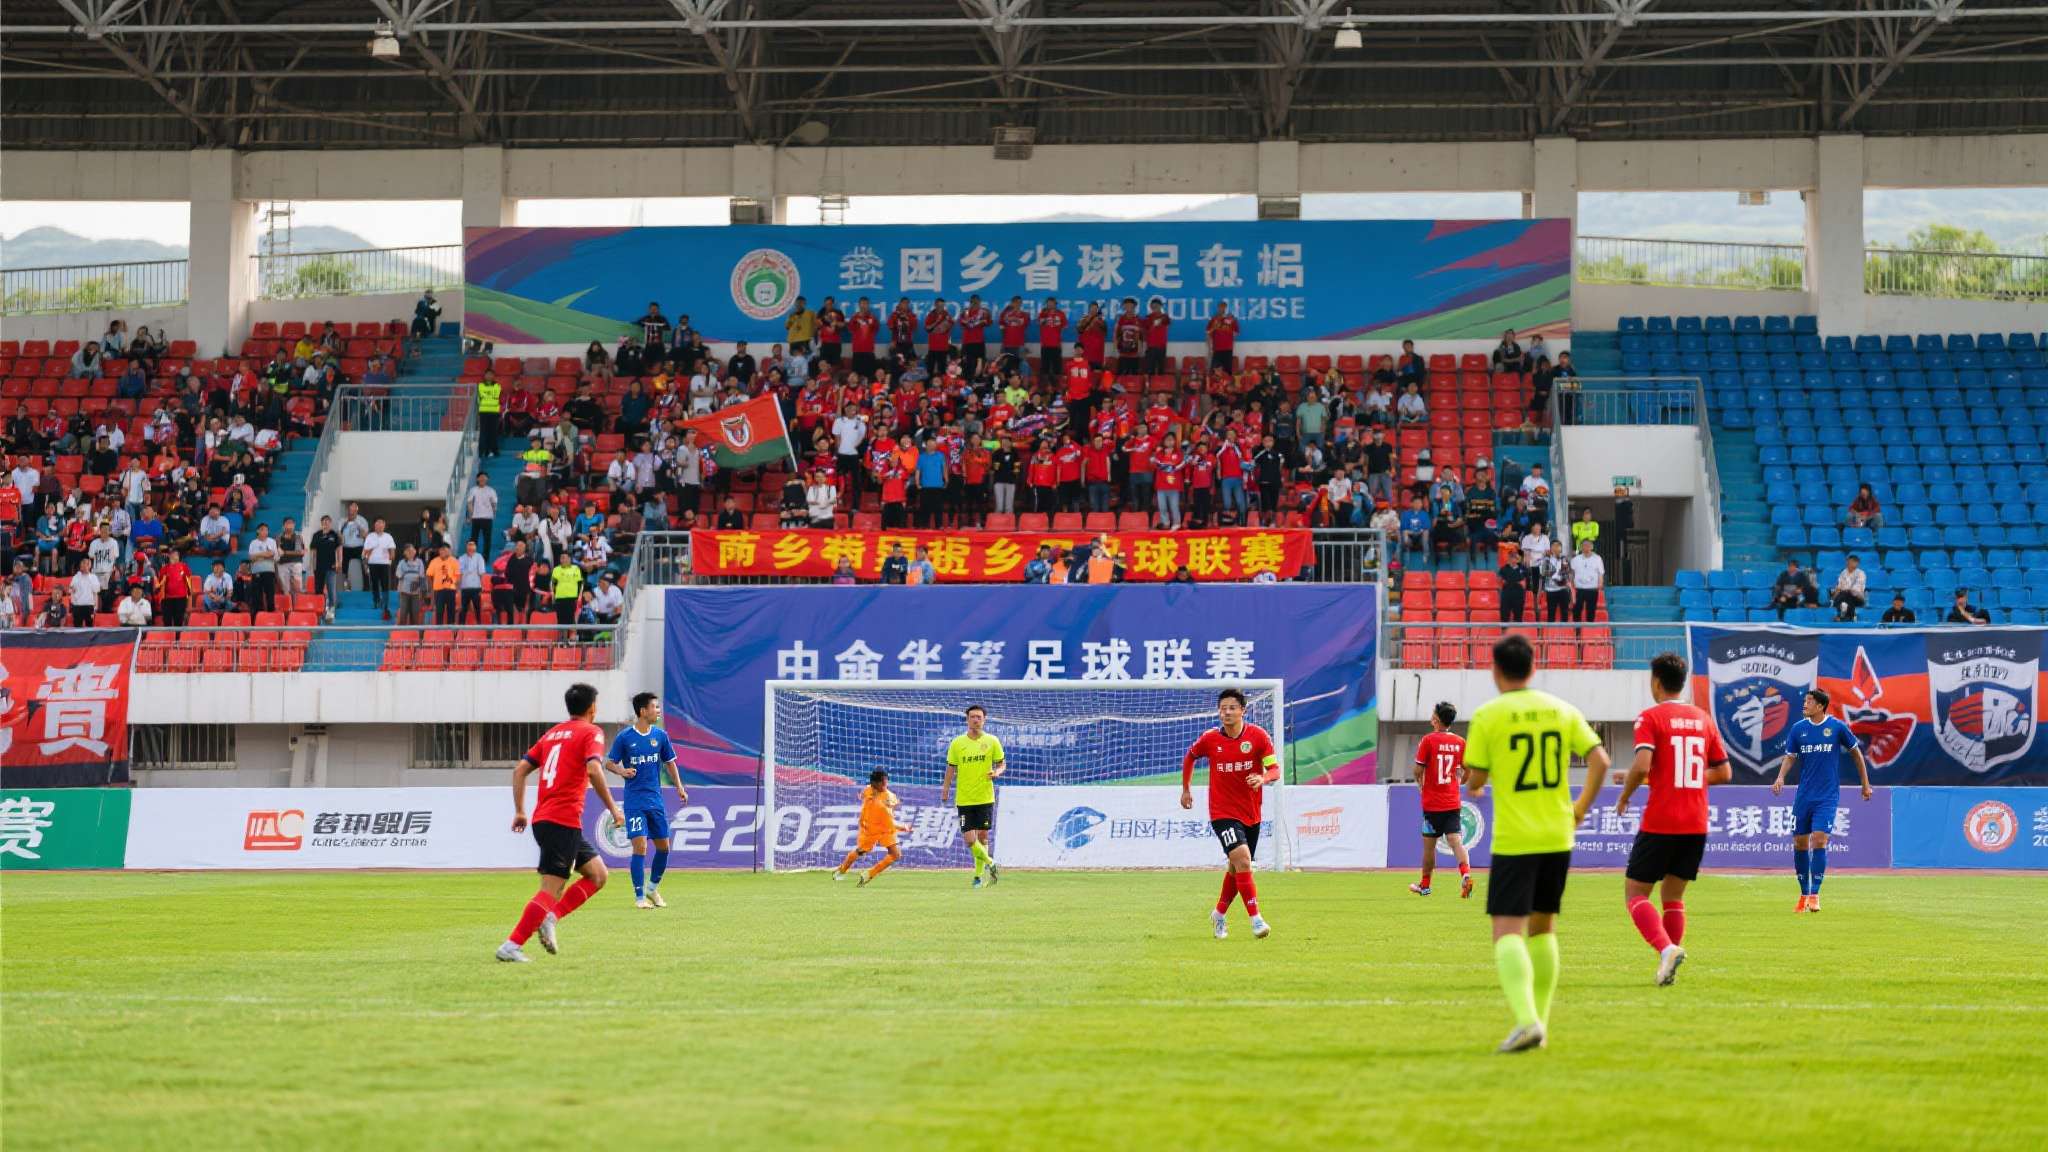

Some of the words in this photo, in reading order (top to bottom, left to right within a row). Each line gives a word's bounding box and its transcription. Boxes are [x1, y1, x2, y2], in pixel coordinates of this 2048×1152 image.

[542, 742, 562, 789] 4
[1509, 730, 1562, 793] 20
[1669, 735, 1706, 789] 16
